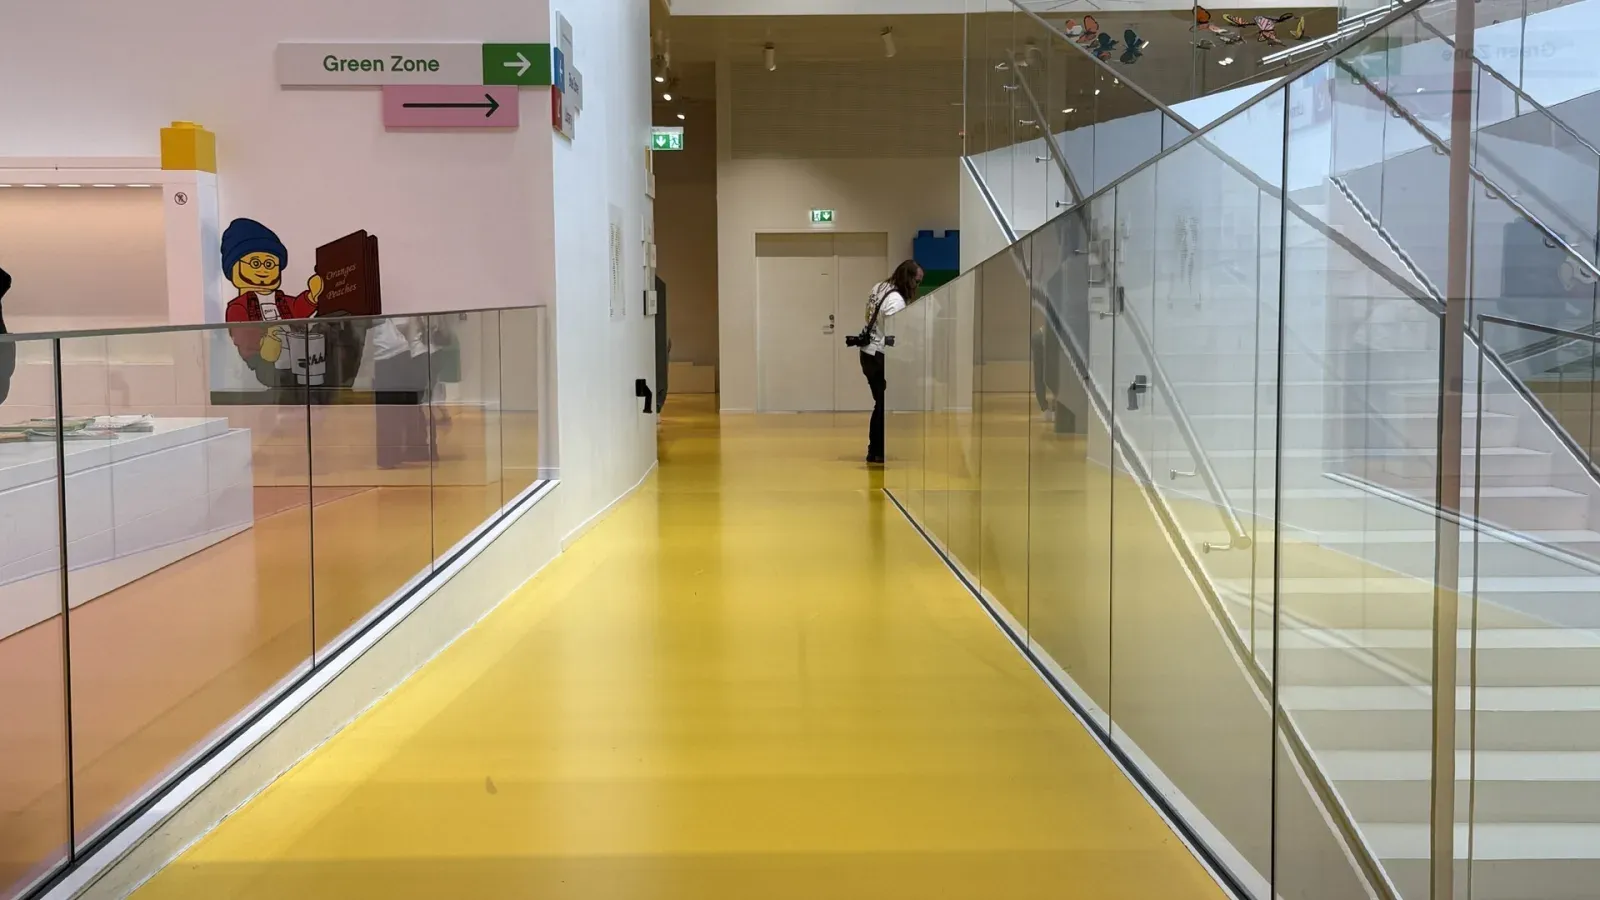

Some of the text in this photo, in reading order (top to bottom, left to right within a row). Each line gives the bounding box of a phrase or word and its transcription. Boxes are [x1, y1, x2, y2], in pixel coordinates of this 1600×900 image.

[323, 54, 440, 72] Green Zone
[326, 263, 357, 281] Oranges
[335, 276, 346, 287] and
[326, 283, 357, 300] Peaches
